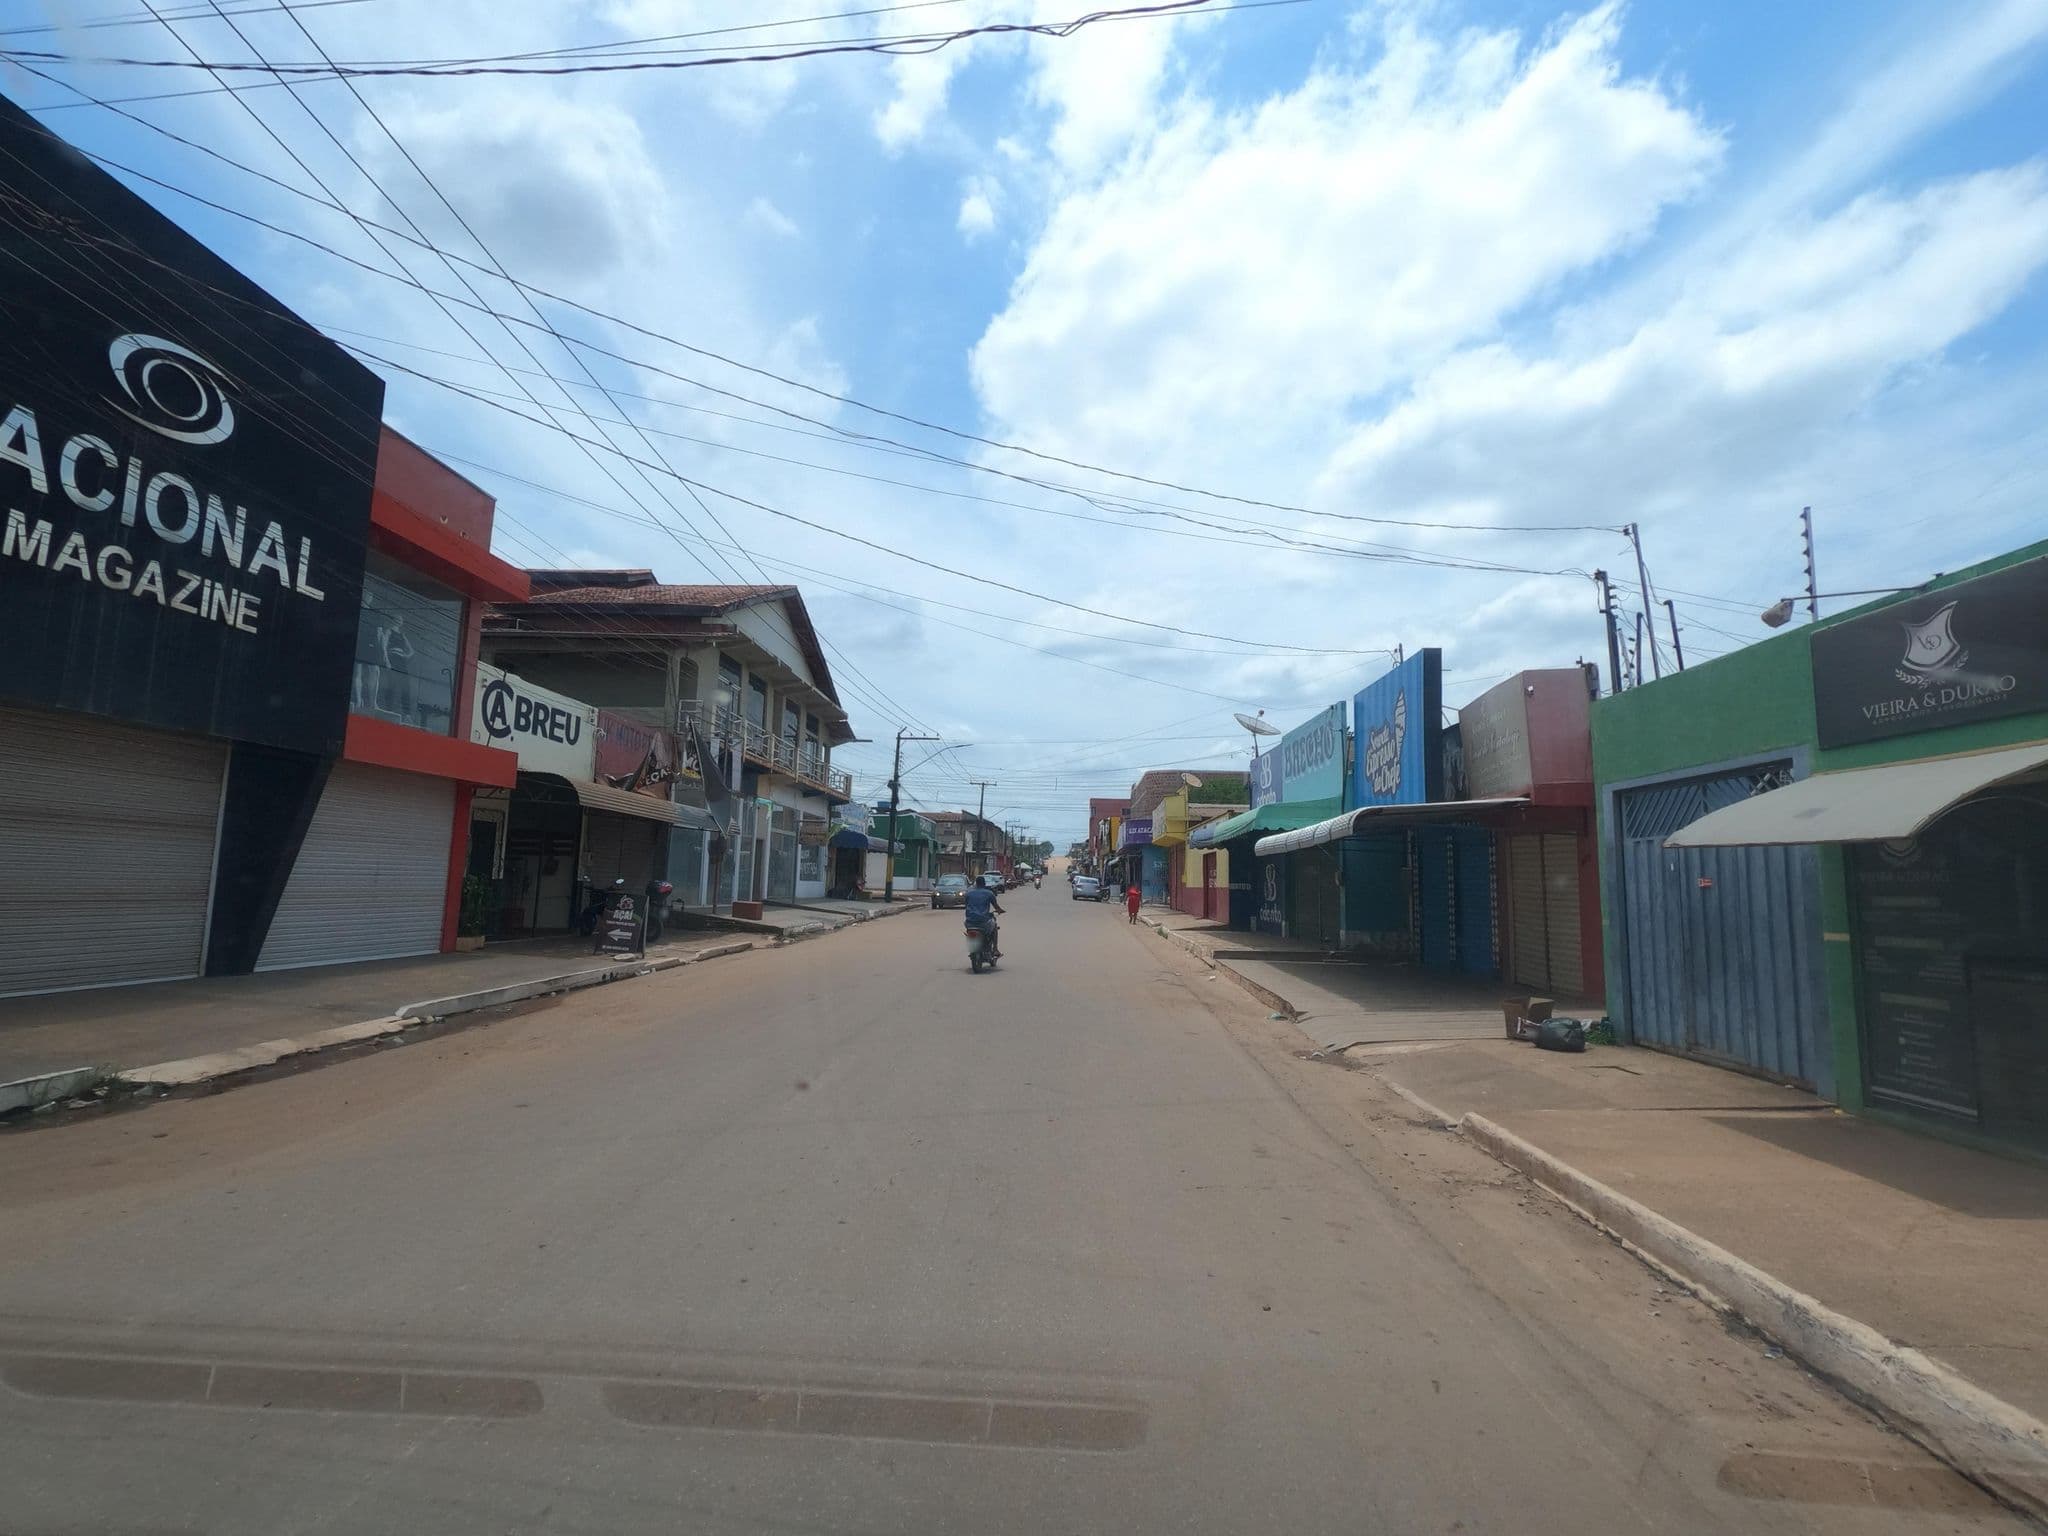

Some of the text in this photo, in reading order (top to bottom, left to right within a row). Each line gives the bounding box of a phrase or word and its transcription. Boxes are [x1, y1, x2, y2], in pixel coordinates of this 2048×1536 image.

[3, 508, 261, 634] MAGAZINE
[1862, 697, 1919, 719] VIEIRA
[1923, 692, 1936, 708] &
